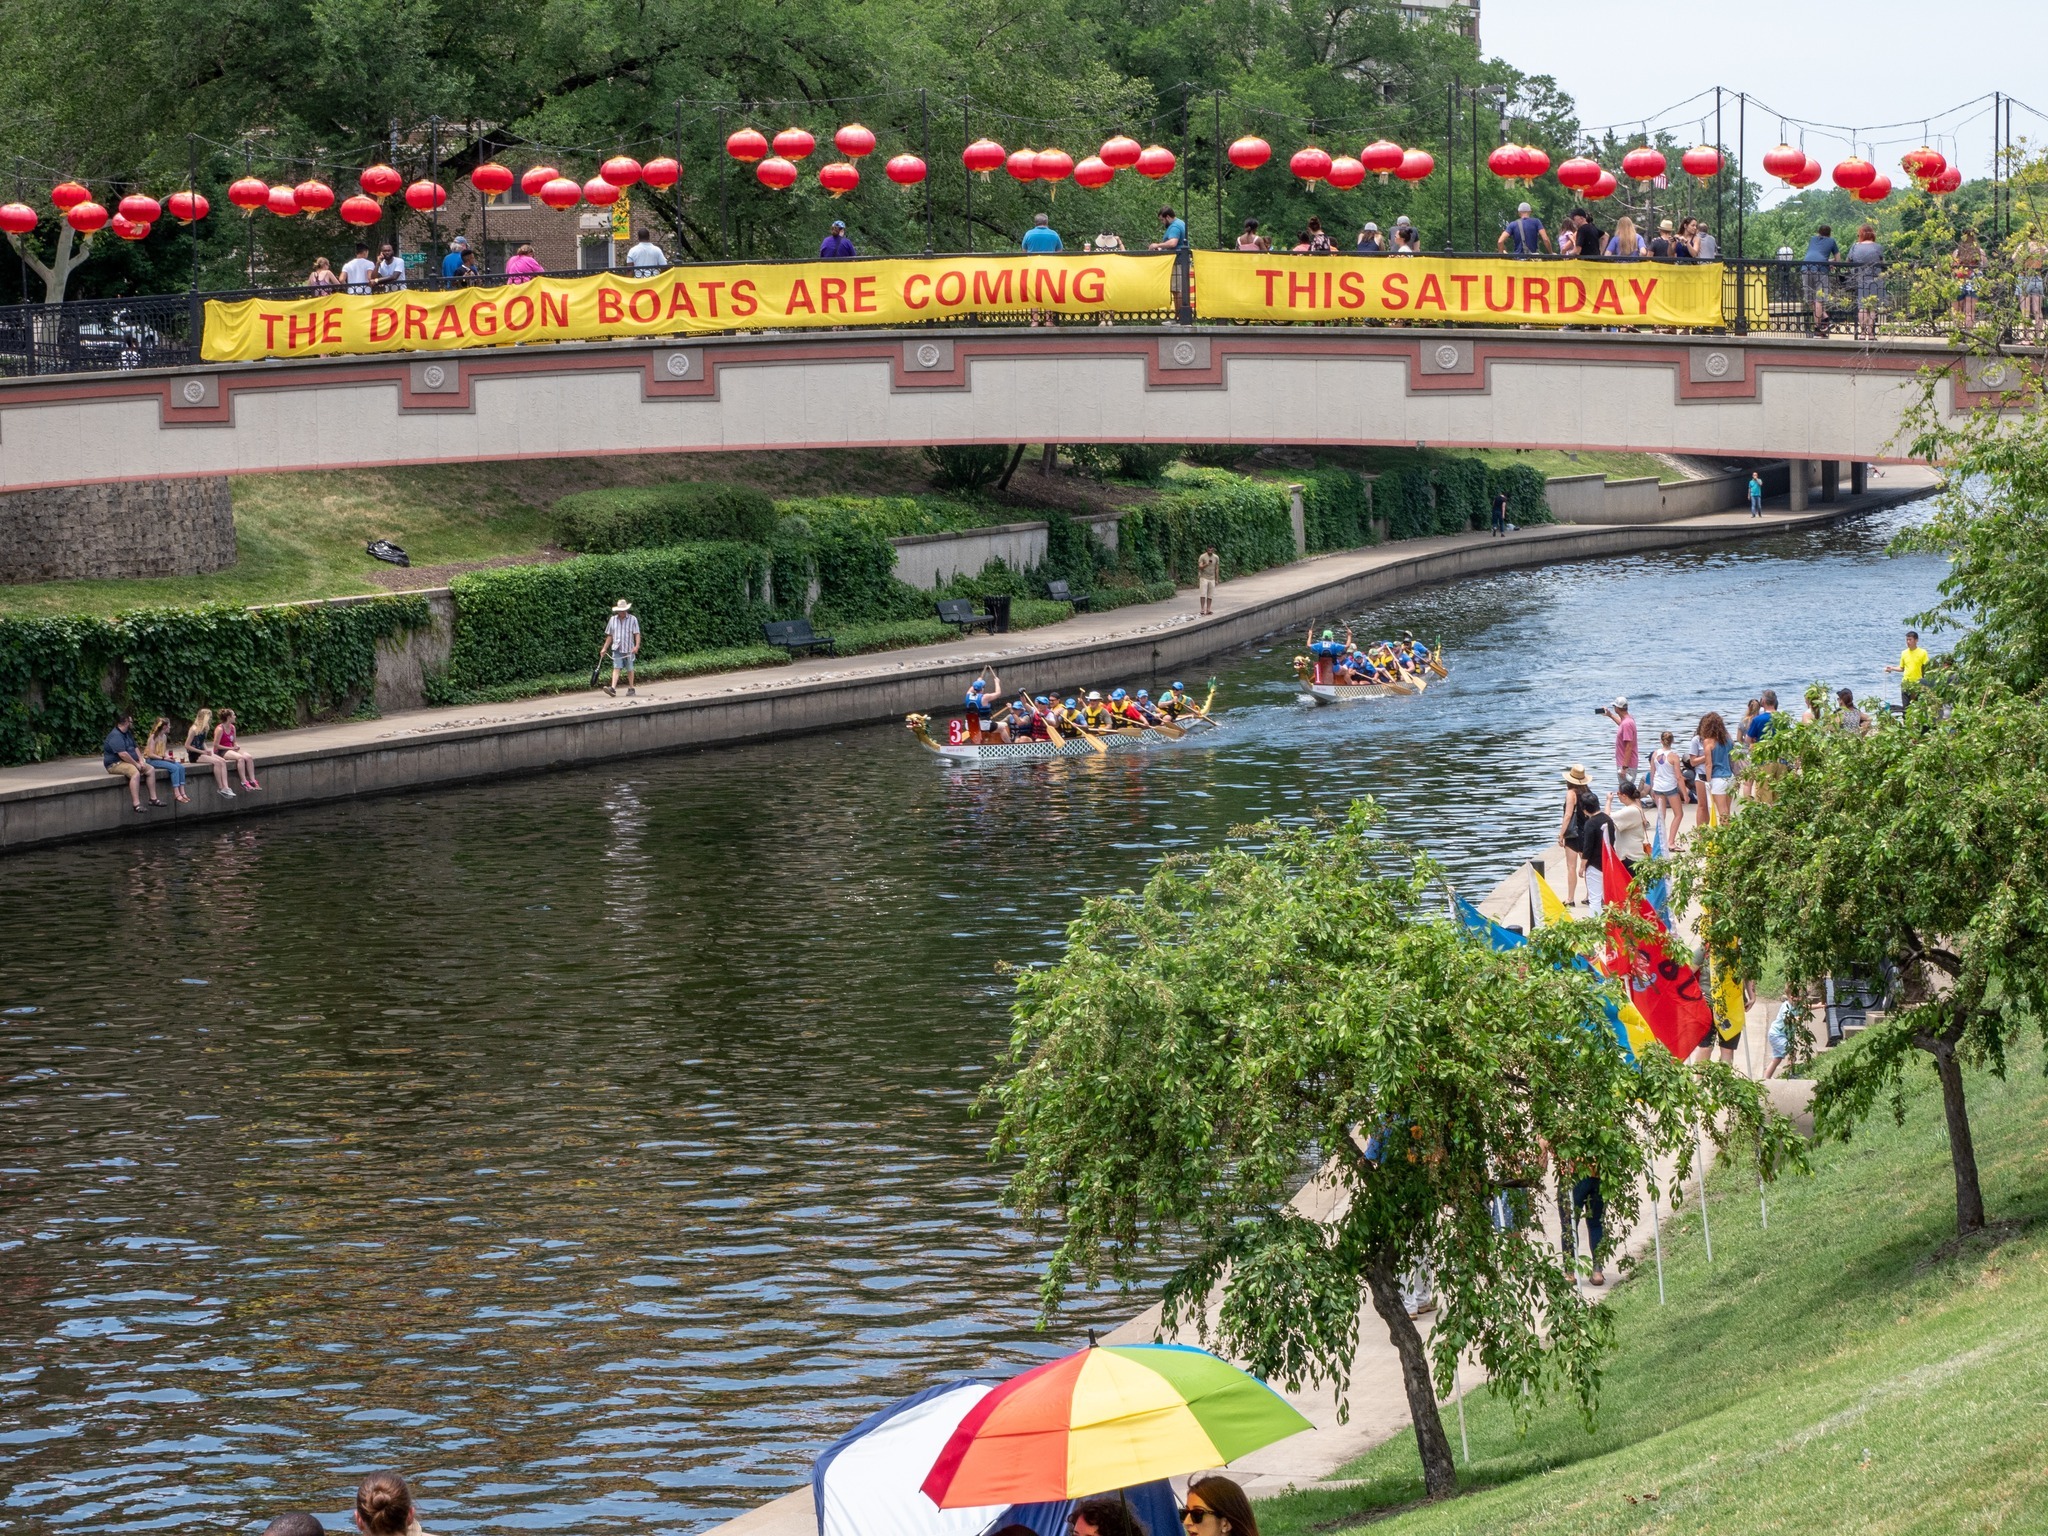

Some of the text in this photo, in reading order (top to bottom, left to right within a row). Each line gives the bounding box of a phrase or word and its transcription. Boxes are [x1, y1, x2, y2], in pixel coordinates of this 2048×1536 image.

[259, 267, 1106, 350] THE DRAGON BOATS ARE COMING
[1255, 269, 1659, 315] THIS SATURDAY
[950, 720, 962, 743] 3
